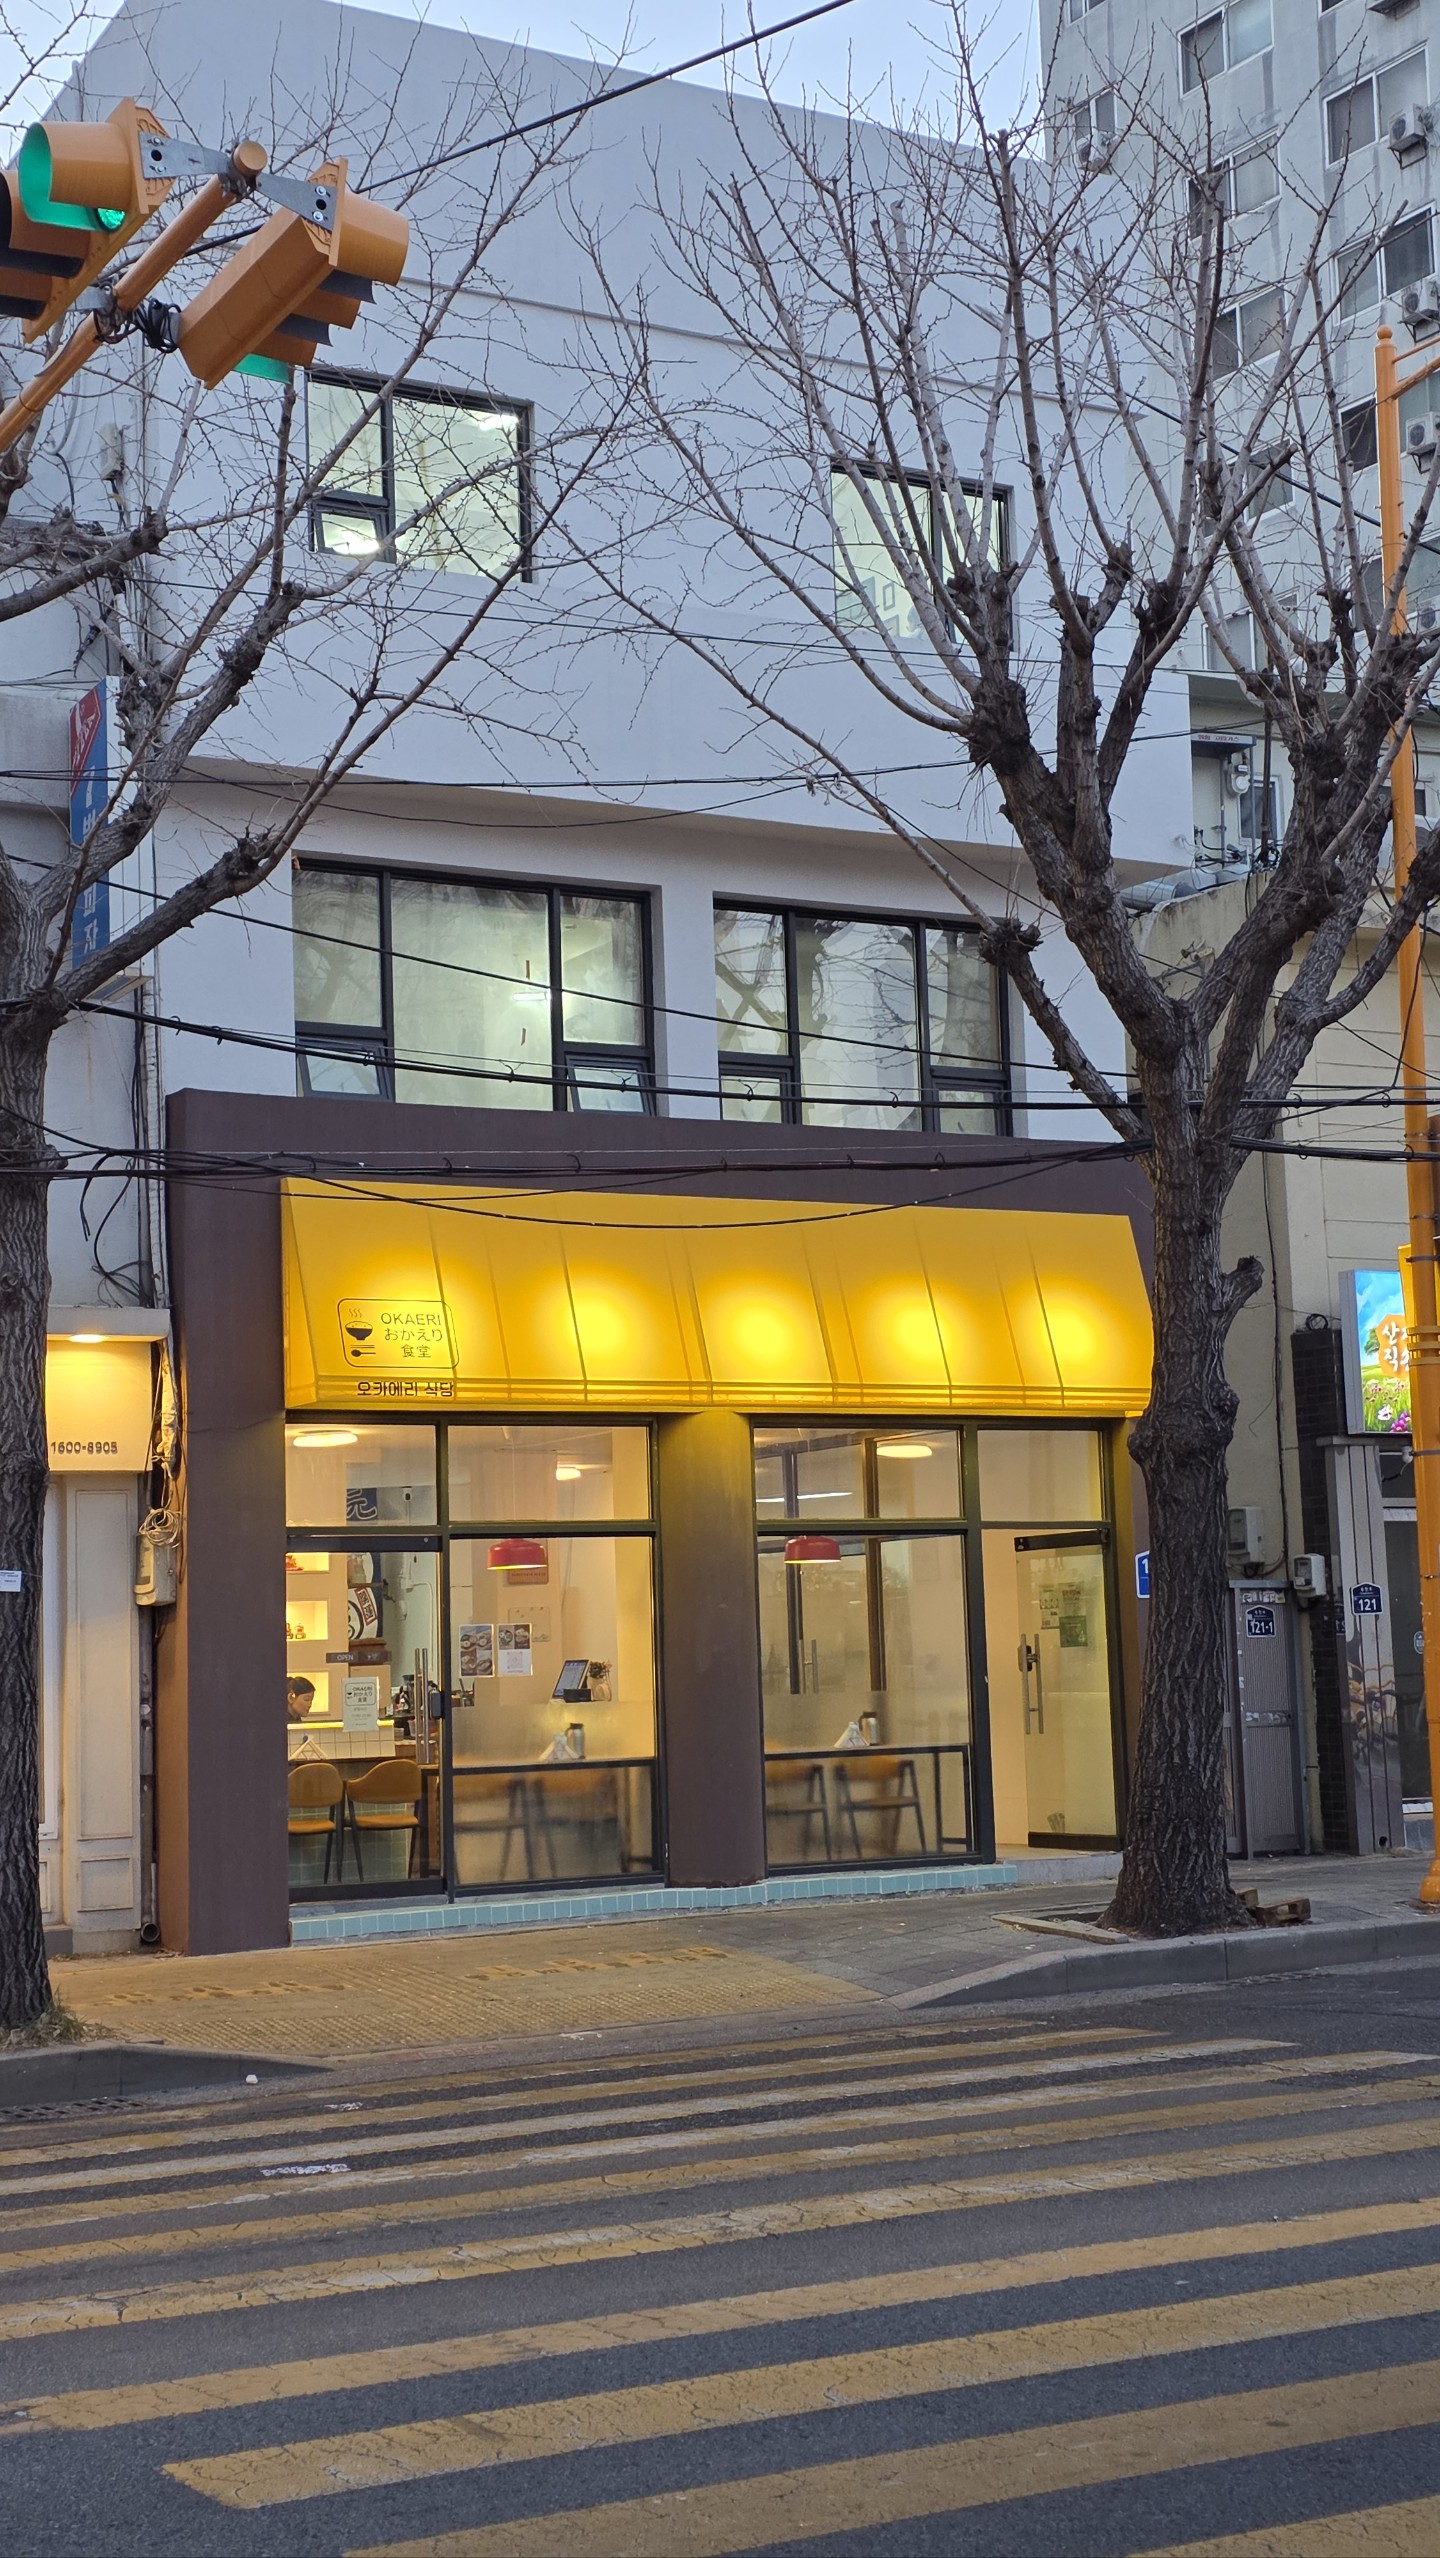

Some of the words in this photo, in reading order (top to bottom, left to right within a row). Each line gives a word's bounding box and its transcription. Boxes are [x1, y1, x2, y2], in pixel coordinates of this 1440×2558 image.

[381, 1313, 442, 1326] OKAERI
[384, 1328, 443, 1342] おかえり
[401, 1344, 431, 1358] 食堂
[357, 1381, 418, 1397] 오카에리
[424, 1381, 454, 1397] 식당
[51, 1441, 118, 1455] 1600-8905
[1358, 1598, 1377, 1611] 121
[1250, 1621, 1273, 1633] 121-1
